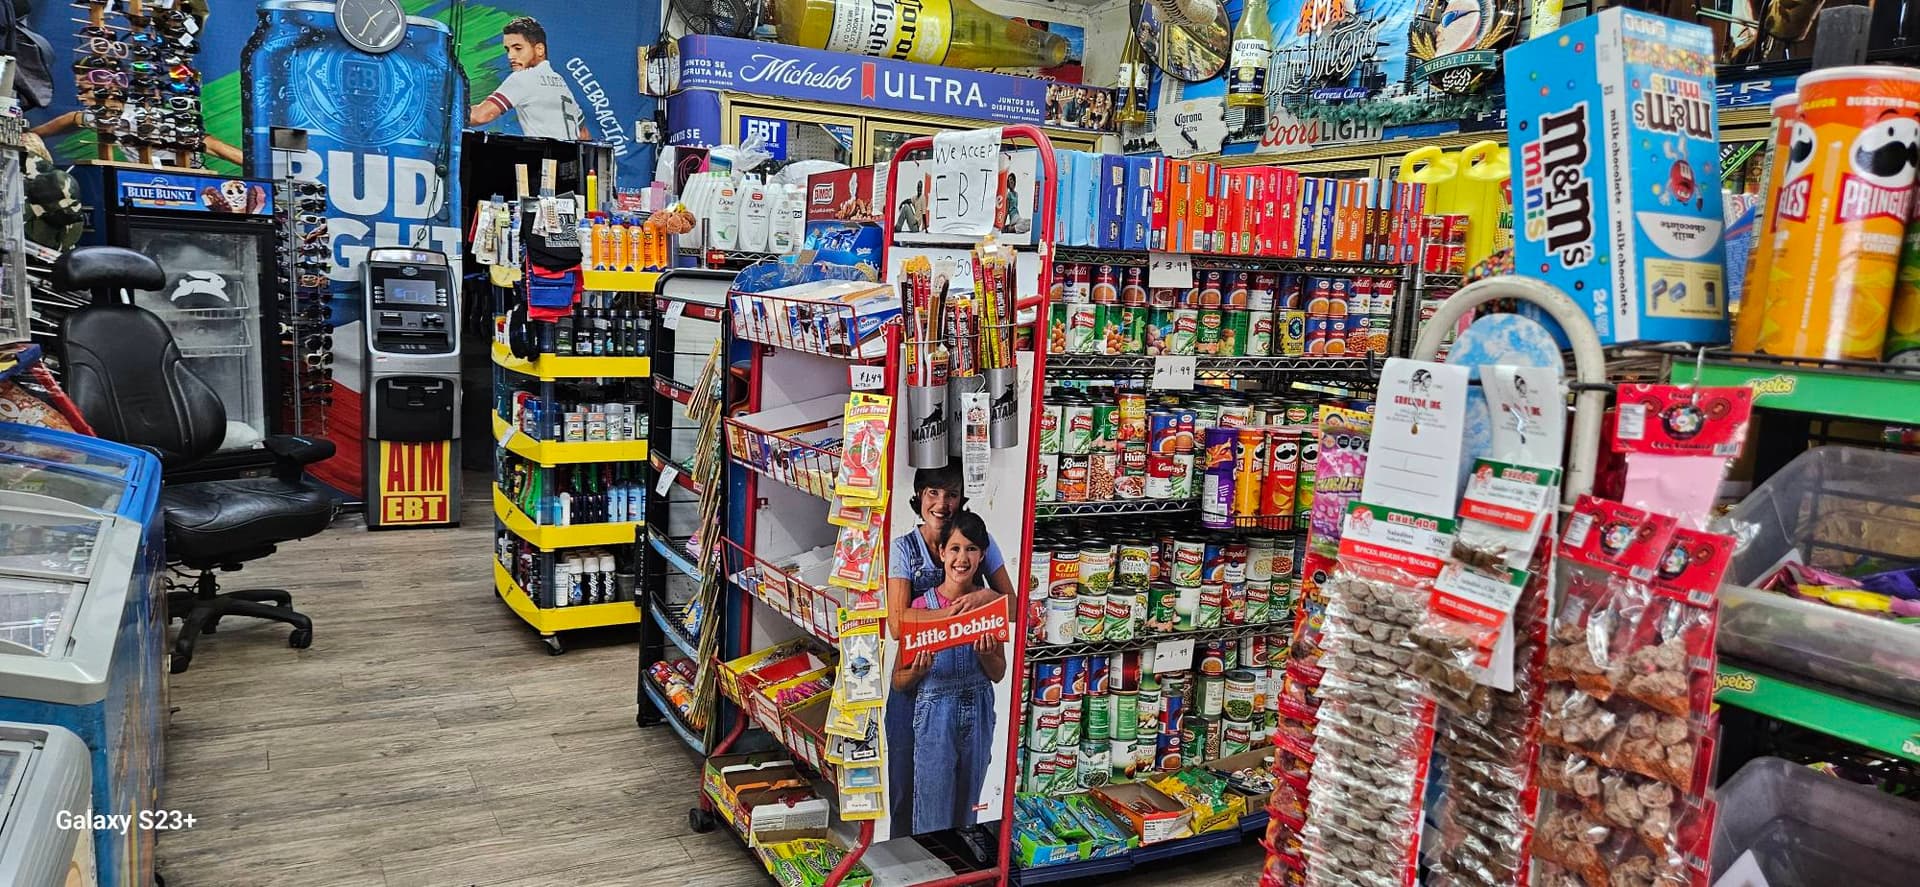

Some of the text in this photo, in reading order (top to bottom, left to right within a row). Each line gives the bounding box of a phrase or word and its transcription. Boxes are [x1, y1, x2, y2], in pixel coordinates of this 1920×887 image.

[1234, 41, 1264, 51] Corona
[685, 59, 725, 68] UNTOS SE
[1424, 57, 1457, 72] WHEAT
[740, 54, 986, 108] Michelob ULTRA
[998, 96, 1024, 106] JUNTOS
[1314, 89, 1365, 100] Cerveza Clara
[566, 57, 629, 156] CELEBRACIÓN
[992, 103, 1040, 115] DISFRUTA MÁS
[1175, 112, 1203, 126] Corona
[687, 128, 700, 138] SE
[1262, 116, 1379, 147] Coors LIGHT
[960, 142, 1000, 160] ACCEPT
[1609, 109, 1623, 205] milk chocolate
[127, 186, 155, 198] BLUE
[814, 187, 832, 199] BIMBO
[1523, 142, 1546, 241] minis
[719, 199, 735, 207] Dove
[1615, 220, 1629, 316] milk chocolate
[1749, 377, 1795, 398] heetos
[850, 405, 887, 416] Little Trees
[912, 421, 947, 442] MATADO
[387, 441, 443, 492] ATM
[1274, 460, 1298, 472] PRINGLES
[387, 497, 443, 522] EBT
[1387, 512, 1438, 530] CHULADA
[841, 620, 858, 633] Little
[905, 615, 1005, 650] Little Debbie
